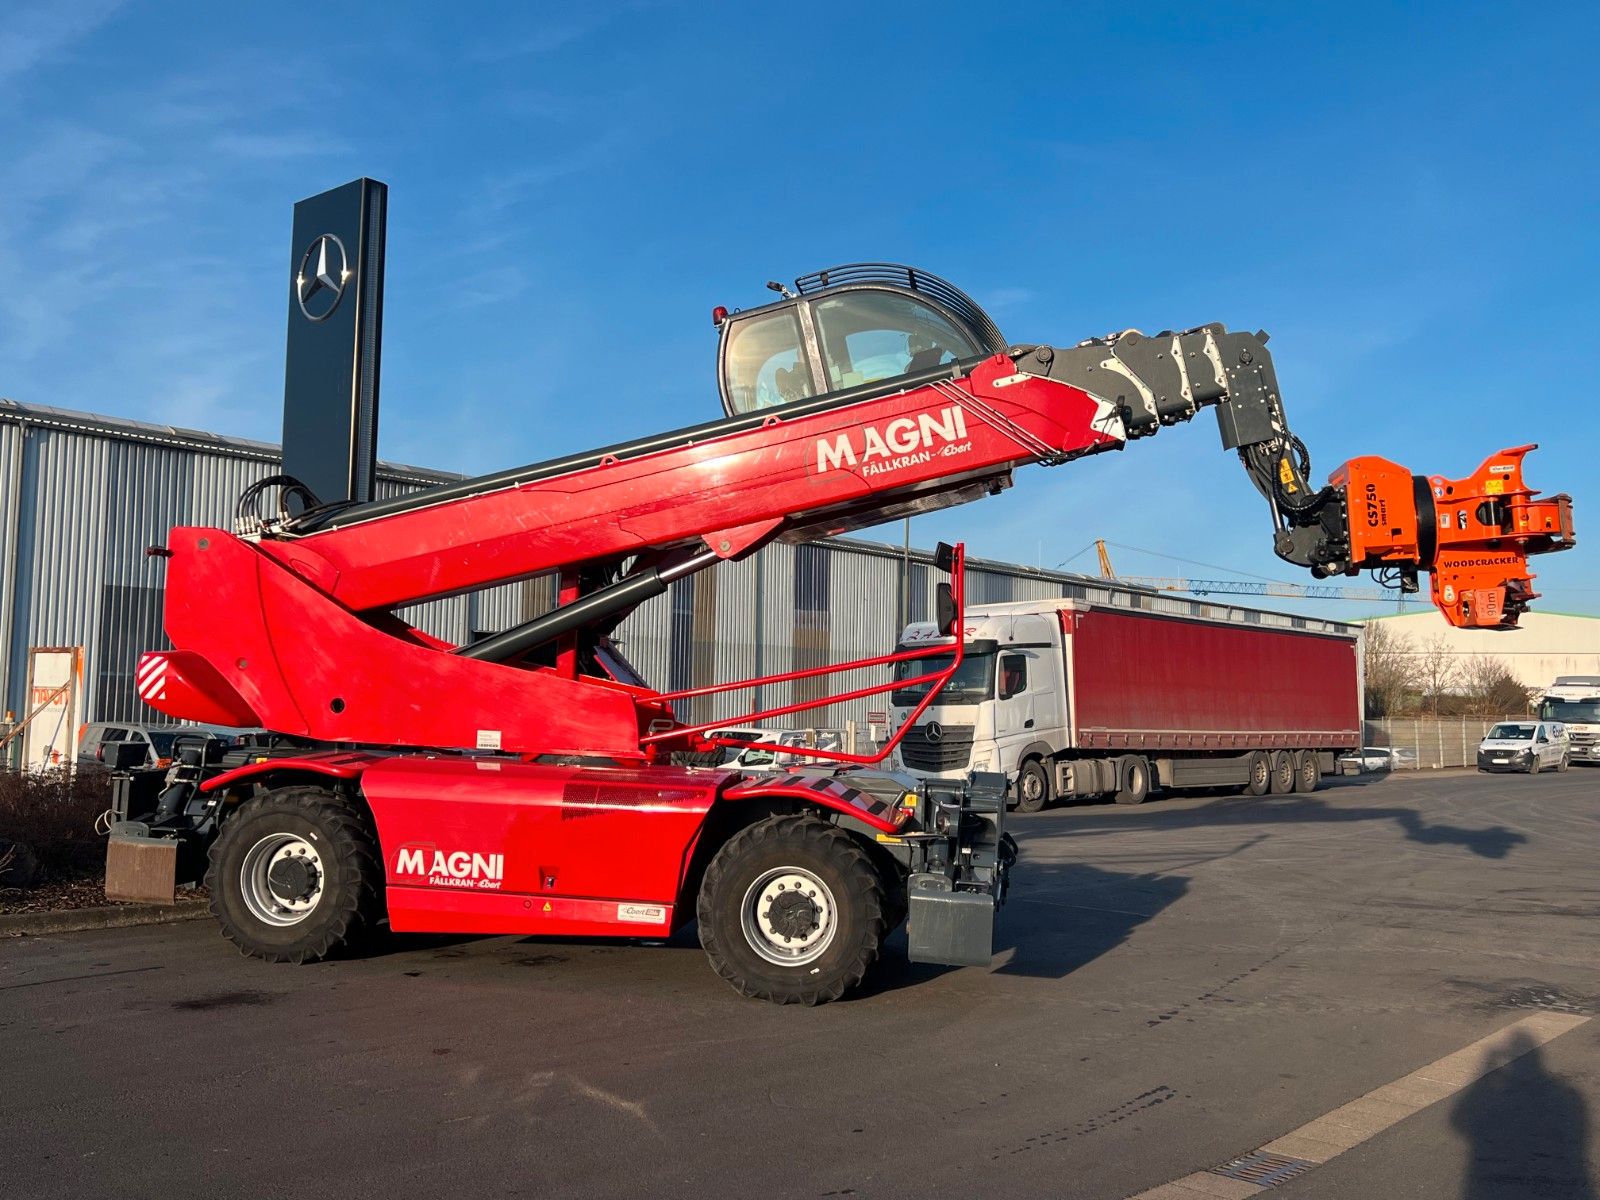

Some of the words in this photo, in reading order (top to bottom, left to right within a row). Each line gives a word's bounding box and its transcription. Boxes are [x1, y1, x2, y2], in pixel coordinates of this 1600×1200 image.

[1366, 483, 1379, 528] CS750
[1379, 499, 1388, 527] smart
[1443, 556, 1519, 569] WOODCRACKER
